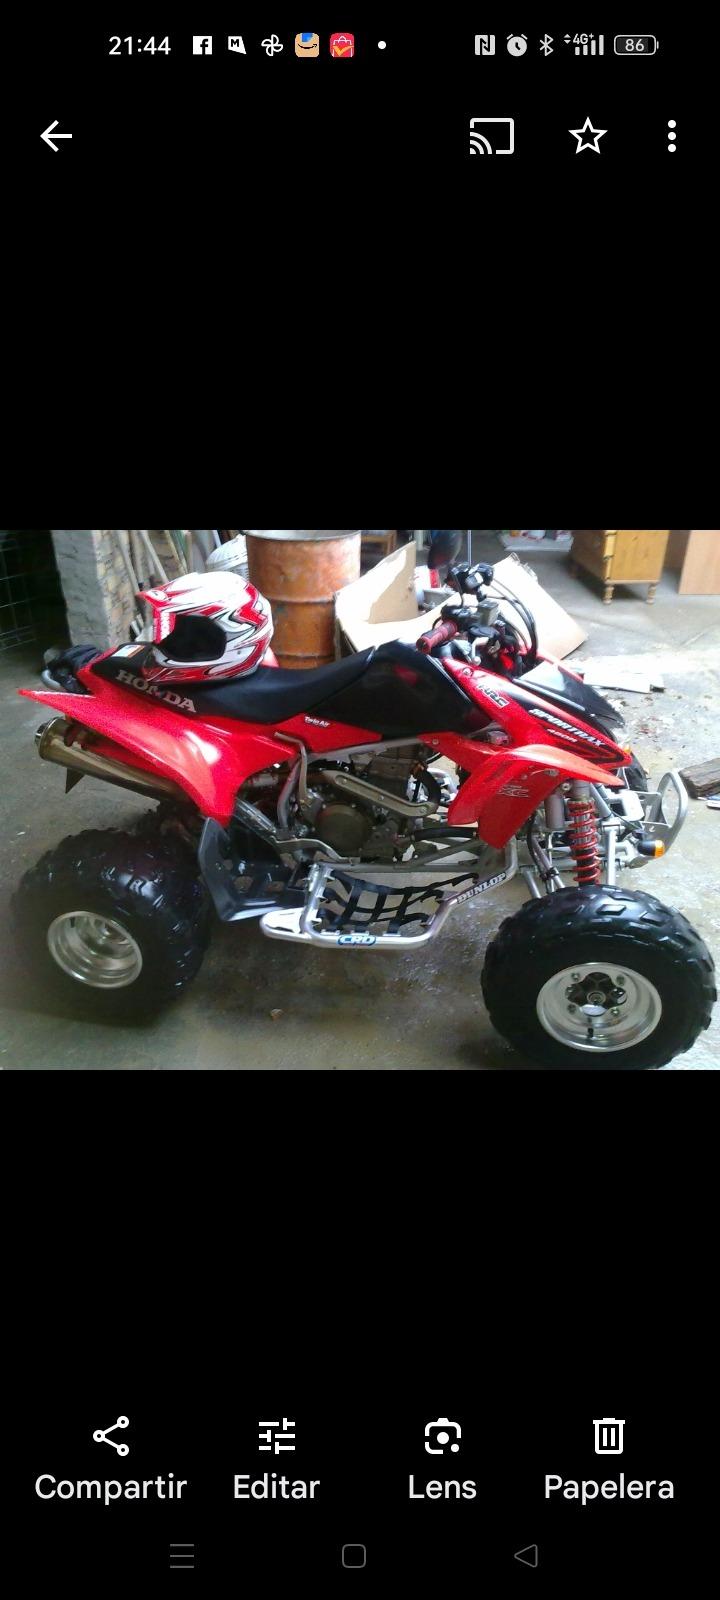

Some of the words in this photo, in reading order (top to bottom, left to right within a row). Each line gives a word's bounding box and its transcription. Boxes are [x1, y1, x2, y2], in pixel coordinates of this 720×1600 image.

[109, 36, 171, 55] 21:44
[625, 38, 645, 52] 86
[115, 669, 197, 713] HONDA
[456, 872, 506, 902] DUNLOP
[338, 934, 375, 946] CRD
[35, 1473, 187, 1505] Compartir
[234, 1473, 320, 1500] Editar
[409, 1474, 476, 1500] Lens
[545, 1473, 673, 1505] Papelera
